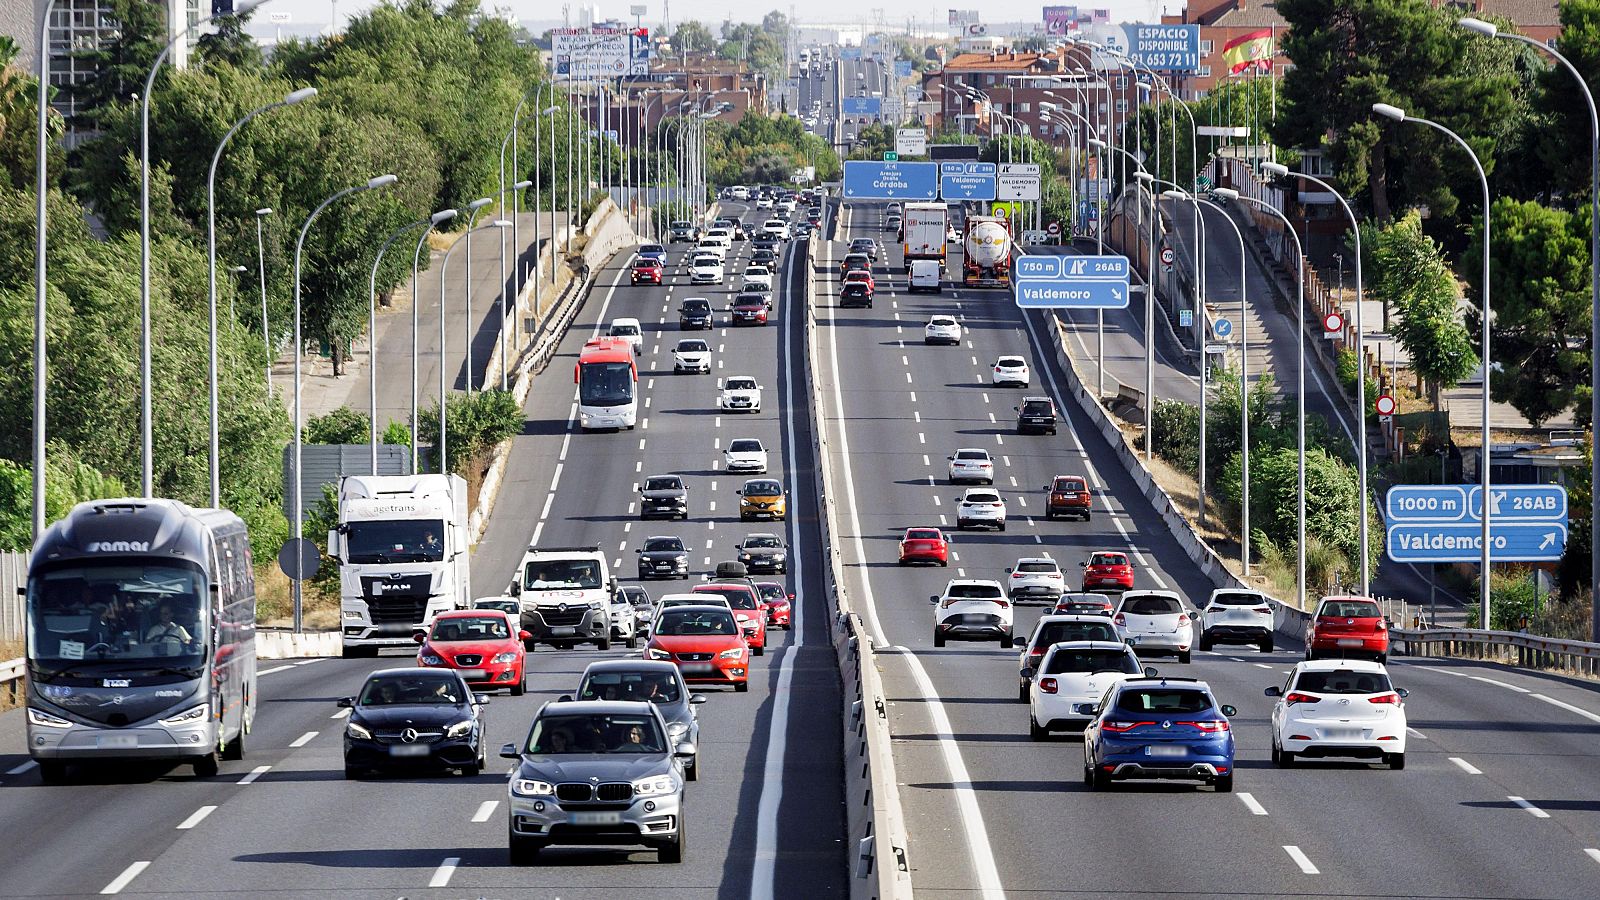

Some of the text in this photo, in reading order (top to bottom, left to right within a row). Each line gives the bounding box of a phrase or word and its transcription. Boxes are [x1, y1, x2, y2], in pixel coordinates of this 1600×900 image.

[1138, 28, 1189, 39] ESPACIO
[1138, 40, 1189, 51] DISPONIBLE
[1146, 53, 1166, 66] 653
[1168, 53, 1182, 66] 72
[1185, 53, 1196, 66] 11
[873, 180, 908, 189] Córdoba
[951, 176, 986, 184] Valdemoro
[1023, 262, 1043, 271] 750
[1095, 262, 1122, 272] 26AB
[1023, 288, 1091, 299] Valdemoro
[1398, 497, 1457, 511] 1000 m
[1513, 496, 1557, 510] 26AB
[85, 540, 150, 553] samar
[1398, 532, 1507, 550] Valdemoro
